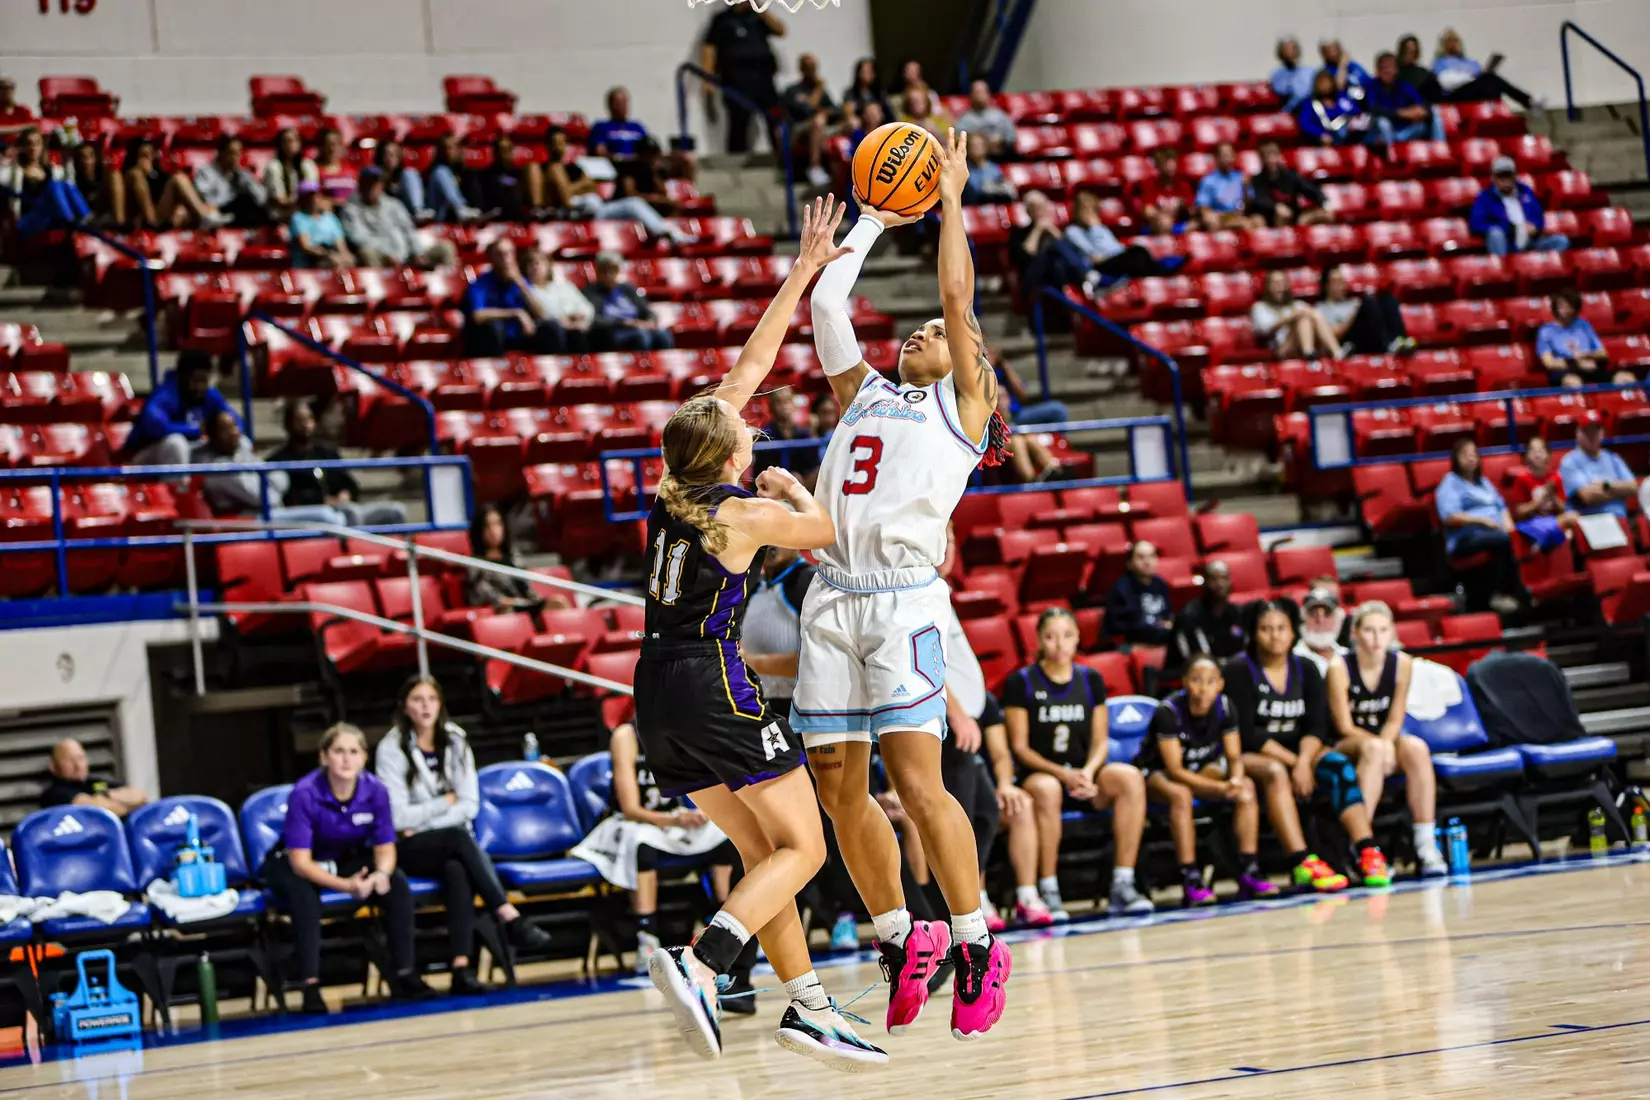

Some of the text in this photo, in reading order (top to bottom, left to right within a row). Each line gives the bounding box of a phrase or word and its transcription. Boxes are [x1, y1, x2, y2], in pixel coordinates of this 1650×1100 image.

[875, 130, 922, 184] Wilson
[842, 435, 884, 496] 3
[649, 527, 691, 606] 11
[1038, 704, 1085, 723] LSUA
[1053, 724, 1070, 753] 2
